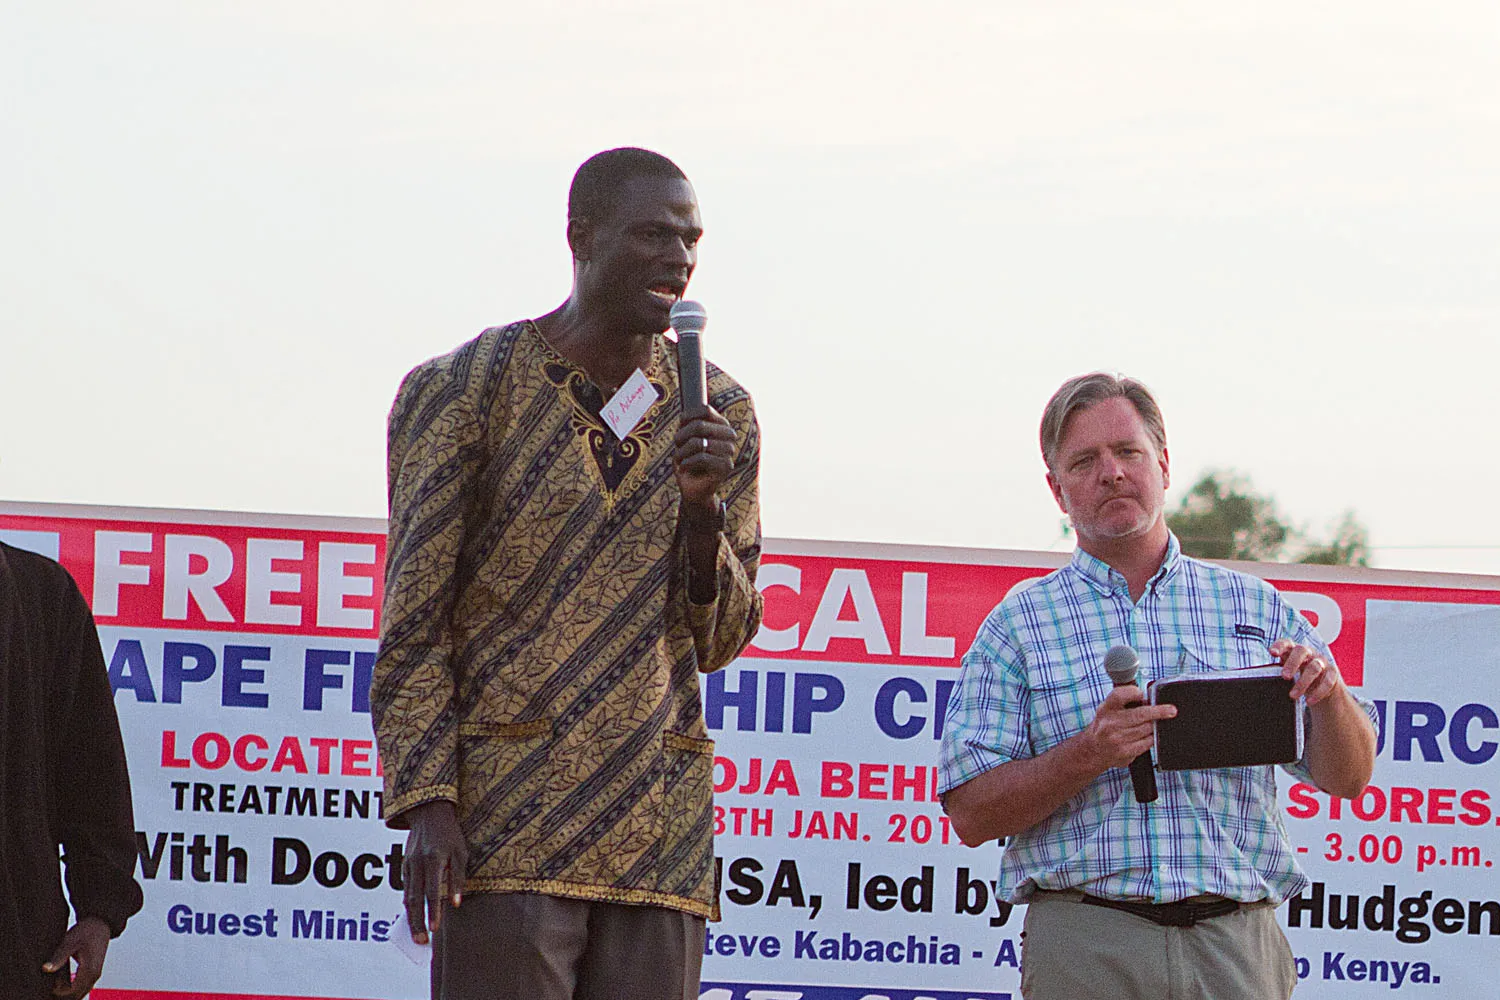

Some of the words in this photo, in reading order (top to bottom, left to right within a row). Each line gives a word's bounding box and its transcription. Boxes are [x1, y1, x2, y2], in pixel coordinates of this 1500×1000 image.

[91, 529, 377, 631] FREE
[161, 730, 384, 777] LOCATE
[787, 809, 871, 842] JAN.
[888, 813, 966, 846] 201
[1324, 832, 1403, 865] 3.00
[1416, 845, 1493, 873] p.m.
[714, 856, 823, 919] SA,
[846, 862, 935, 913] led
[955, 867, 1014, 928] by
[167, 903, 279, 938] Guest
[291, 909, 400, 943] Minis
[794, 931, 961, 966] Kabachia
[994, 939, 1022, 973] A
[1322, 951, 1441, 990] Kenya.
